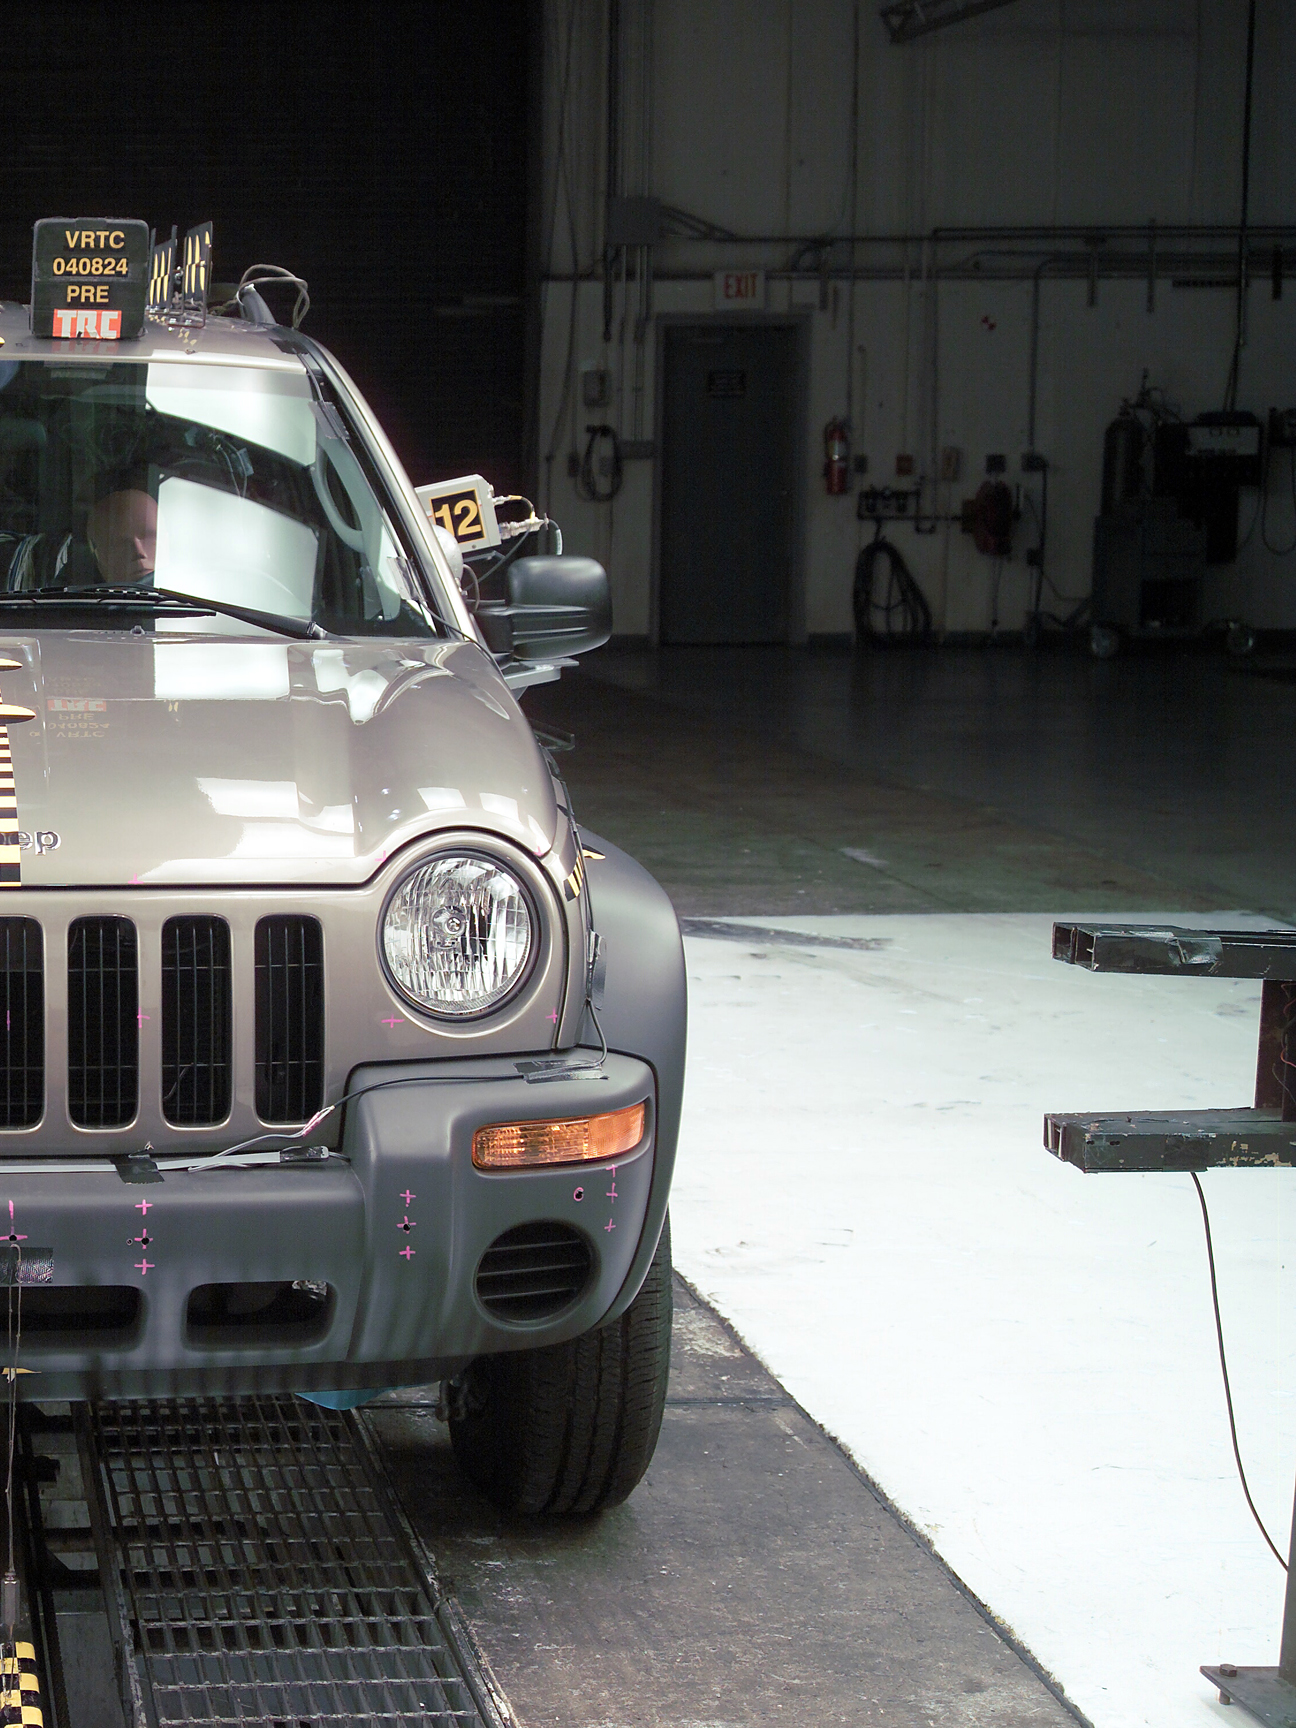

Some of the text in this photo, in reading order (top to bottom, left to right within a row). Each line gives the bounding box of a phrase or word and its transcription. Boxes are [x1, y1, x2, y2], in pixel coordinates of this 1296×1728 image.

[65, 231, 124, 249] VRTC
[53, 257, 128, 275] 040824
[66, 285, 109, 303] PRE
[724, 273, 757, 299] EXIT
[57, 310, 118, 338] TRC
[435, 499, 482, 537] 12
